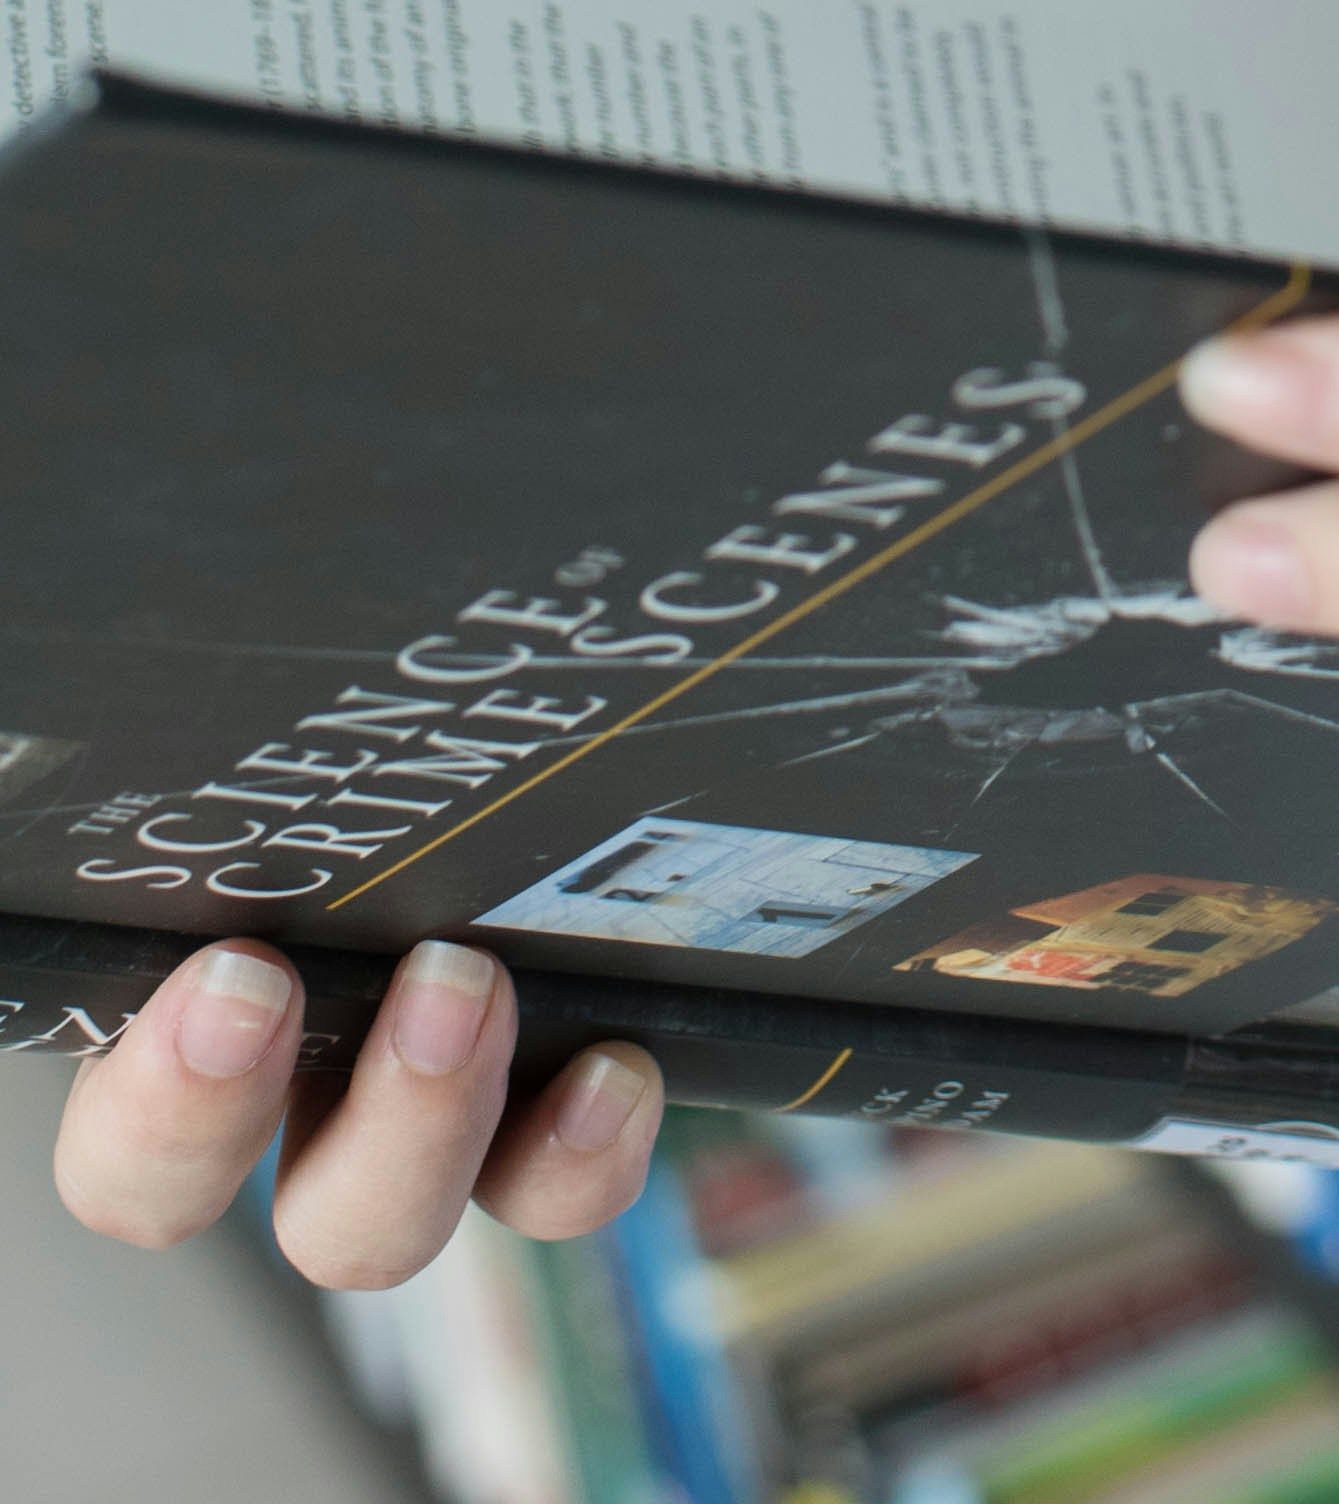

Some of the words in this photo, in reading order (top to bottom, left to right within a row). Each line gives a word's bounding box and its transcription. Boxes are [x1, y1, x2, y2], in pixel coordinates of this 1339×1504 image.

[7, 11, 35, 116] detective
[206, 688, 608, 900] CRIME
[569, 360, 1087, 669] SCENES
[67, 788, 162, 836] THE
[74, 588, 608, 890] SCIENCE
